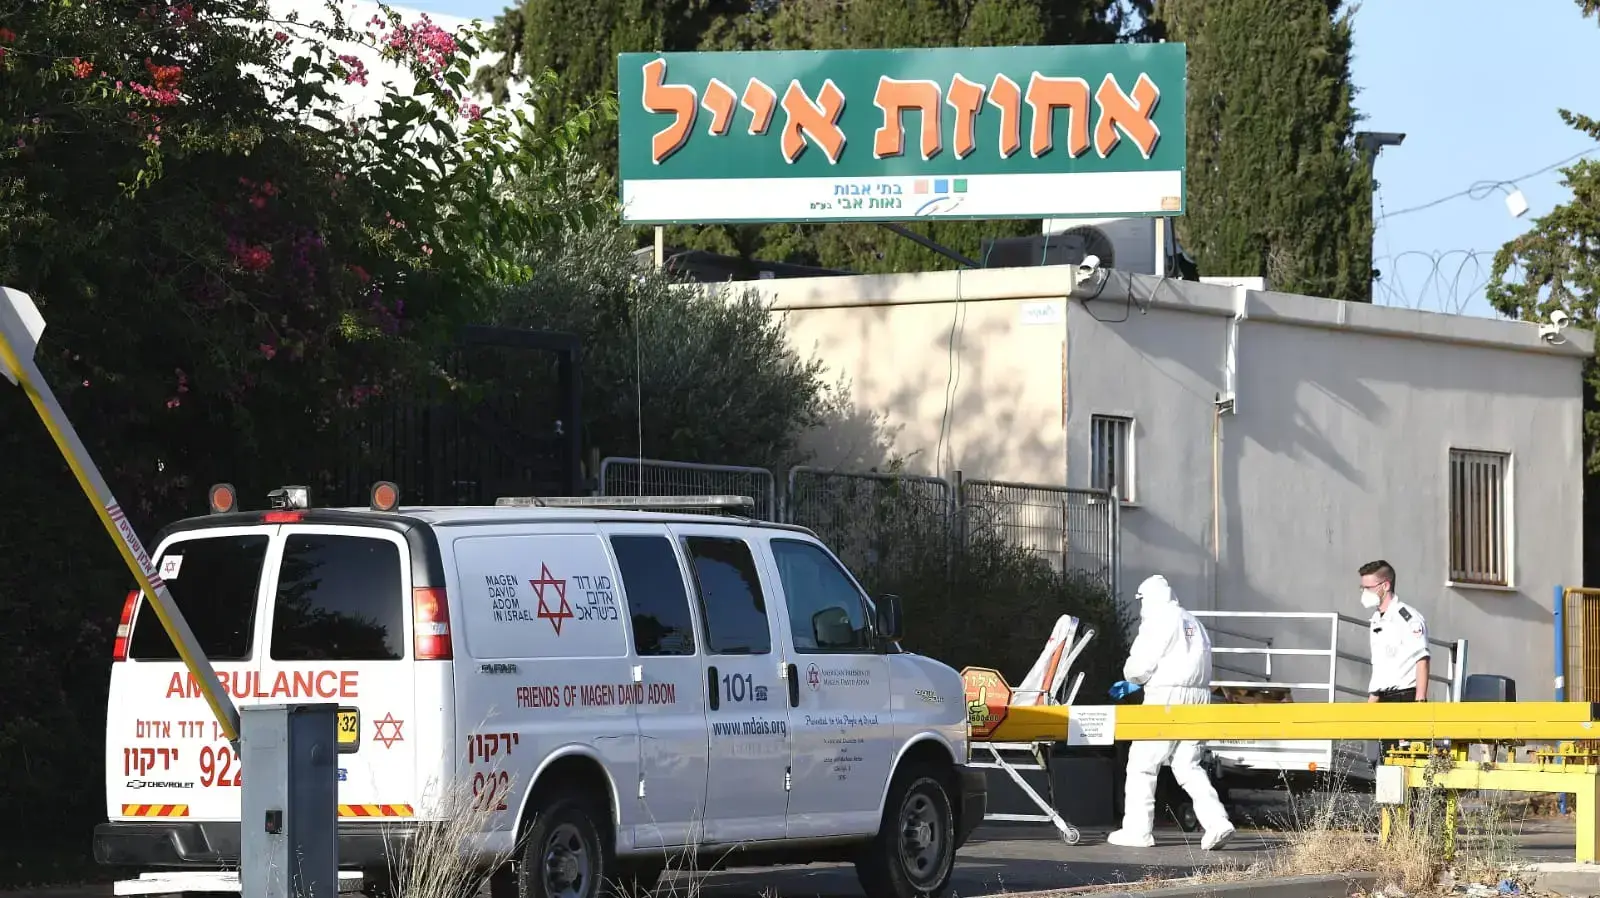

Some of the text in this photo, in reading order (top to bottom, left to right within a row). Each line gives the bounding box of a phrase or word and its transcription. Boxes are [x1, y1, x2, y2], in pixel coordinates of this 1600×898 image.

[642, 58, 1161, 165] אחוזת אייל
[834, 183, 903, 196] בתי אבות
[837, 197, 863, 209] אבי
[868, 197, 902, 209] נאות
[485, 575, 518, 586] MAGEN
[572, 575, 611, 590] מגן דוד
[488, 586, 516, 598] DAVID
[586, 591, 614, 605] אדום
[492, 598, 520, 610] ADOM
[575, 603, 618, 621] בישראל
[493, 610, 534, 622] IN ISRAEL
[166, 670, 359, 698] AMBULANCE
[723, 673, 753, 702] 101
[516, 683, 676, 708] FRIENDS OF MAGEN DAVID ADOM
[136, 718, 171, 738] אדום
[178, 720, 205, 738] דוד
[712, 716, 786, 738] www.mdais.org
[467, 732, 519, 764] ירקון
[124, 747, 179, 777] ירקון
[147, 781, 195, 789] CHEVROLET
